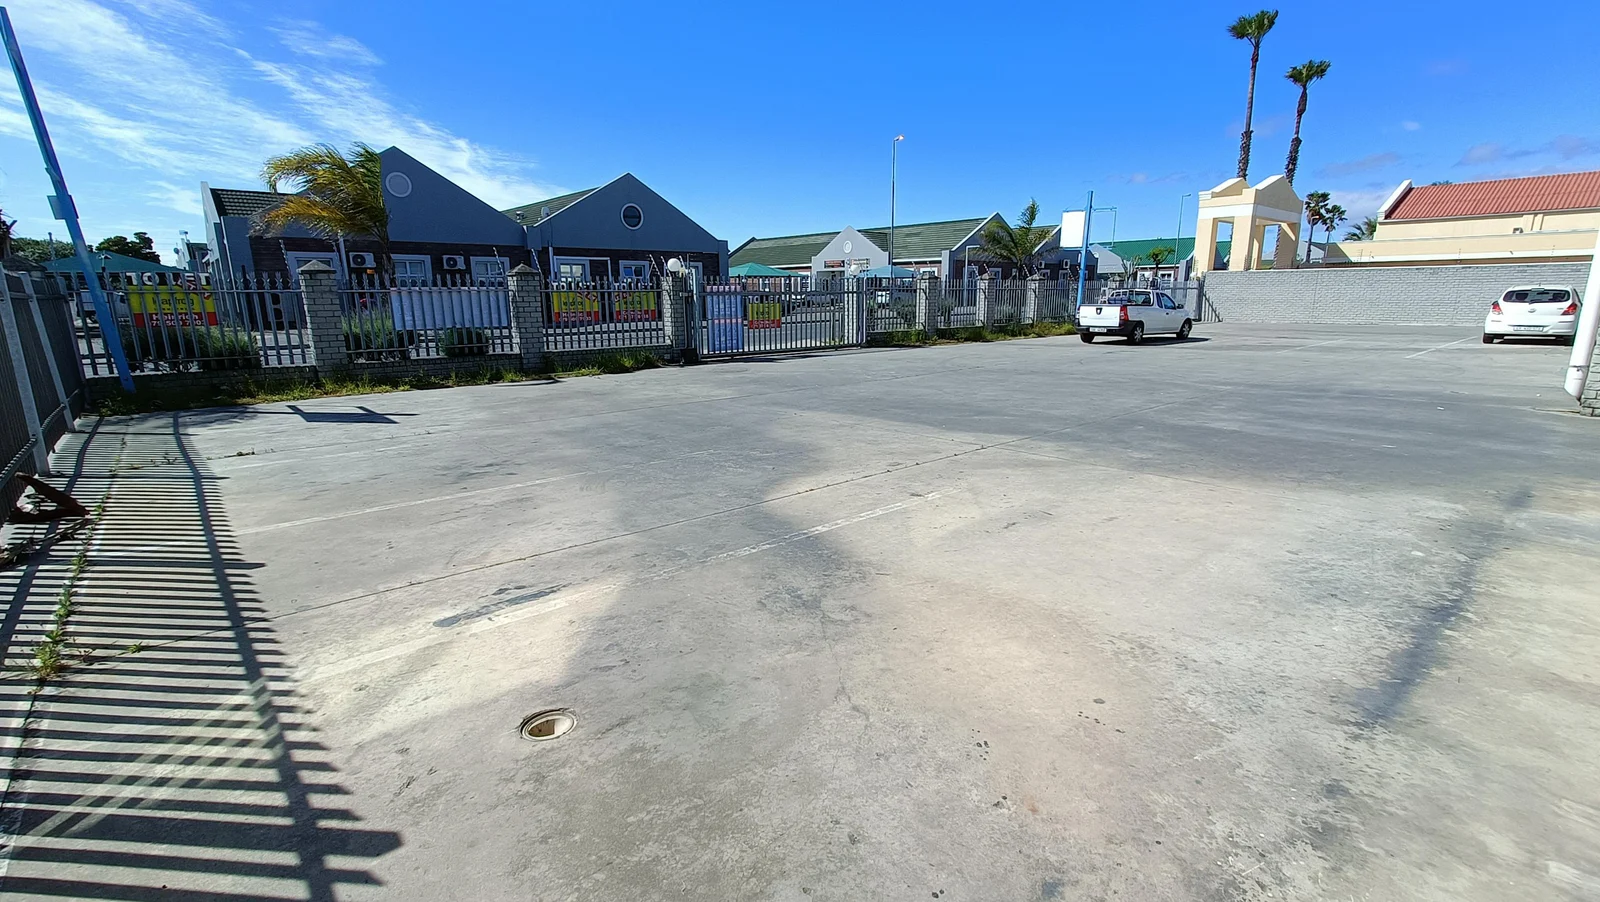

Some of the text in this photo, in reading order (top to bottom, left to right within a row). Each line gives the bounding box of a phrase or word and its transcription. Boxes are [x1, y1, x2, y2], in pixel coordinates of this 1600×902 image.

[126, 272, 209, 285] TO LET
[552, 283, 567, 291] TO
[614, 283, 627, 291] TO
[152, 296, 194, 306] lapfrog
